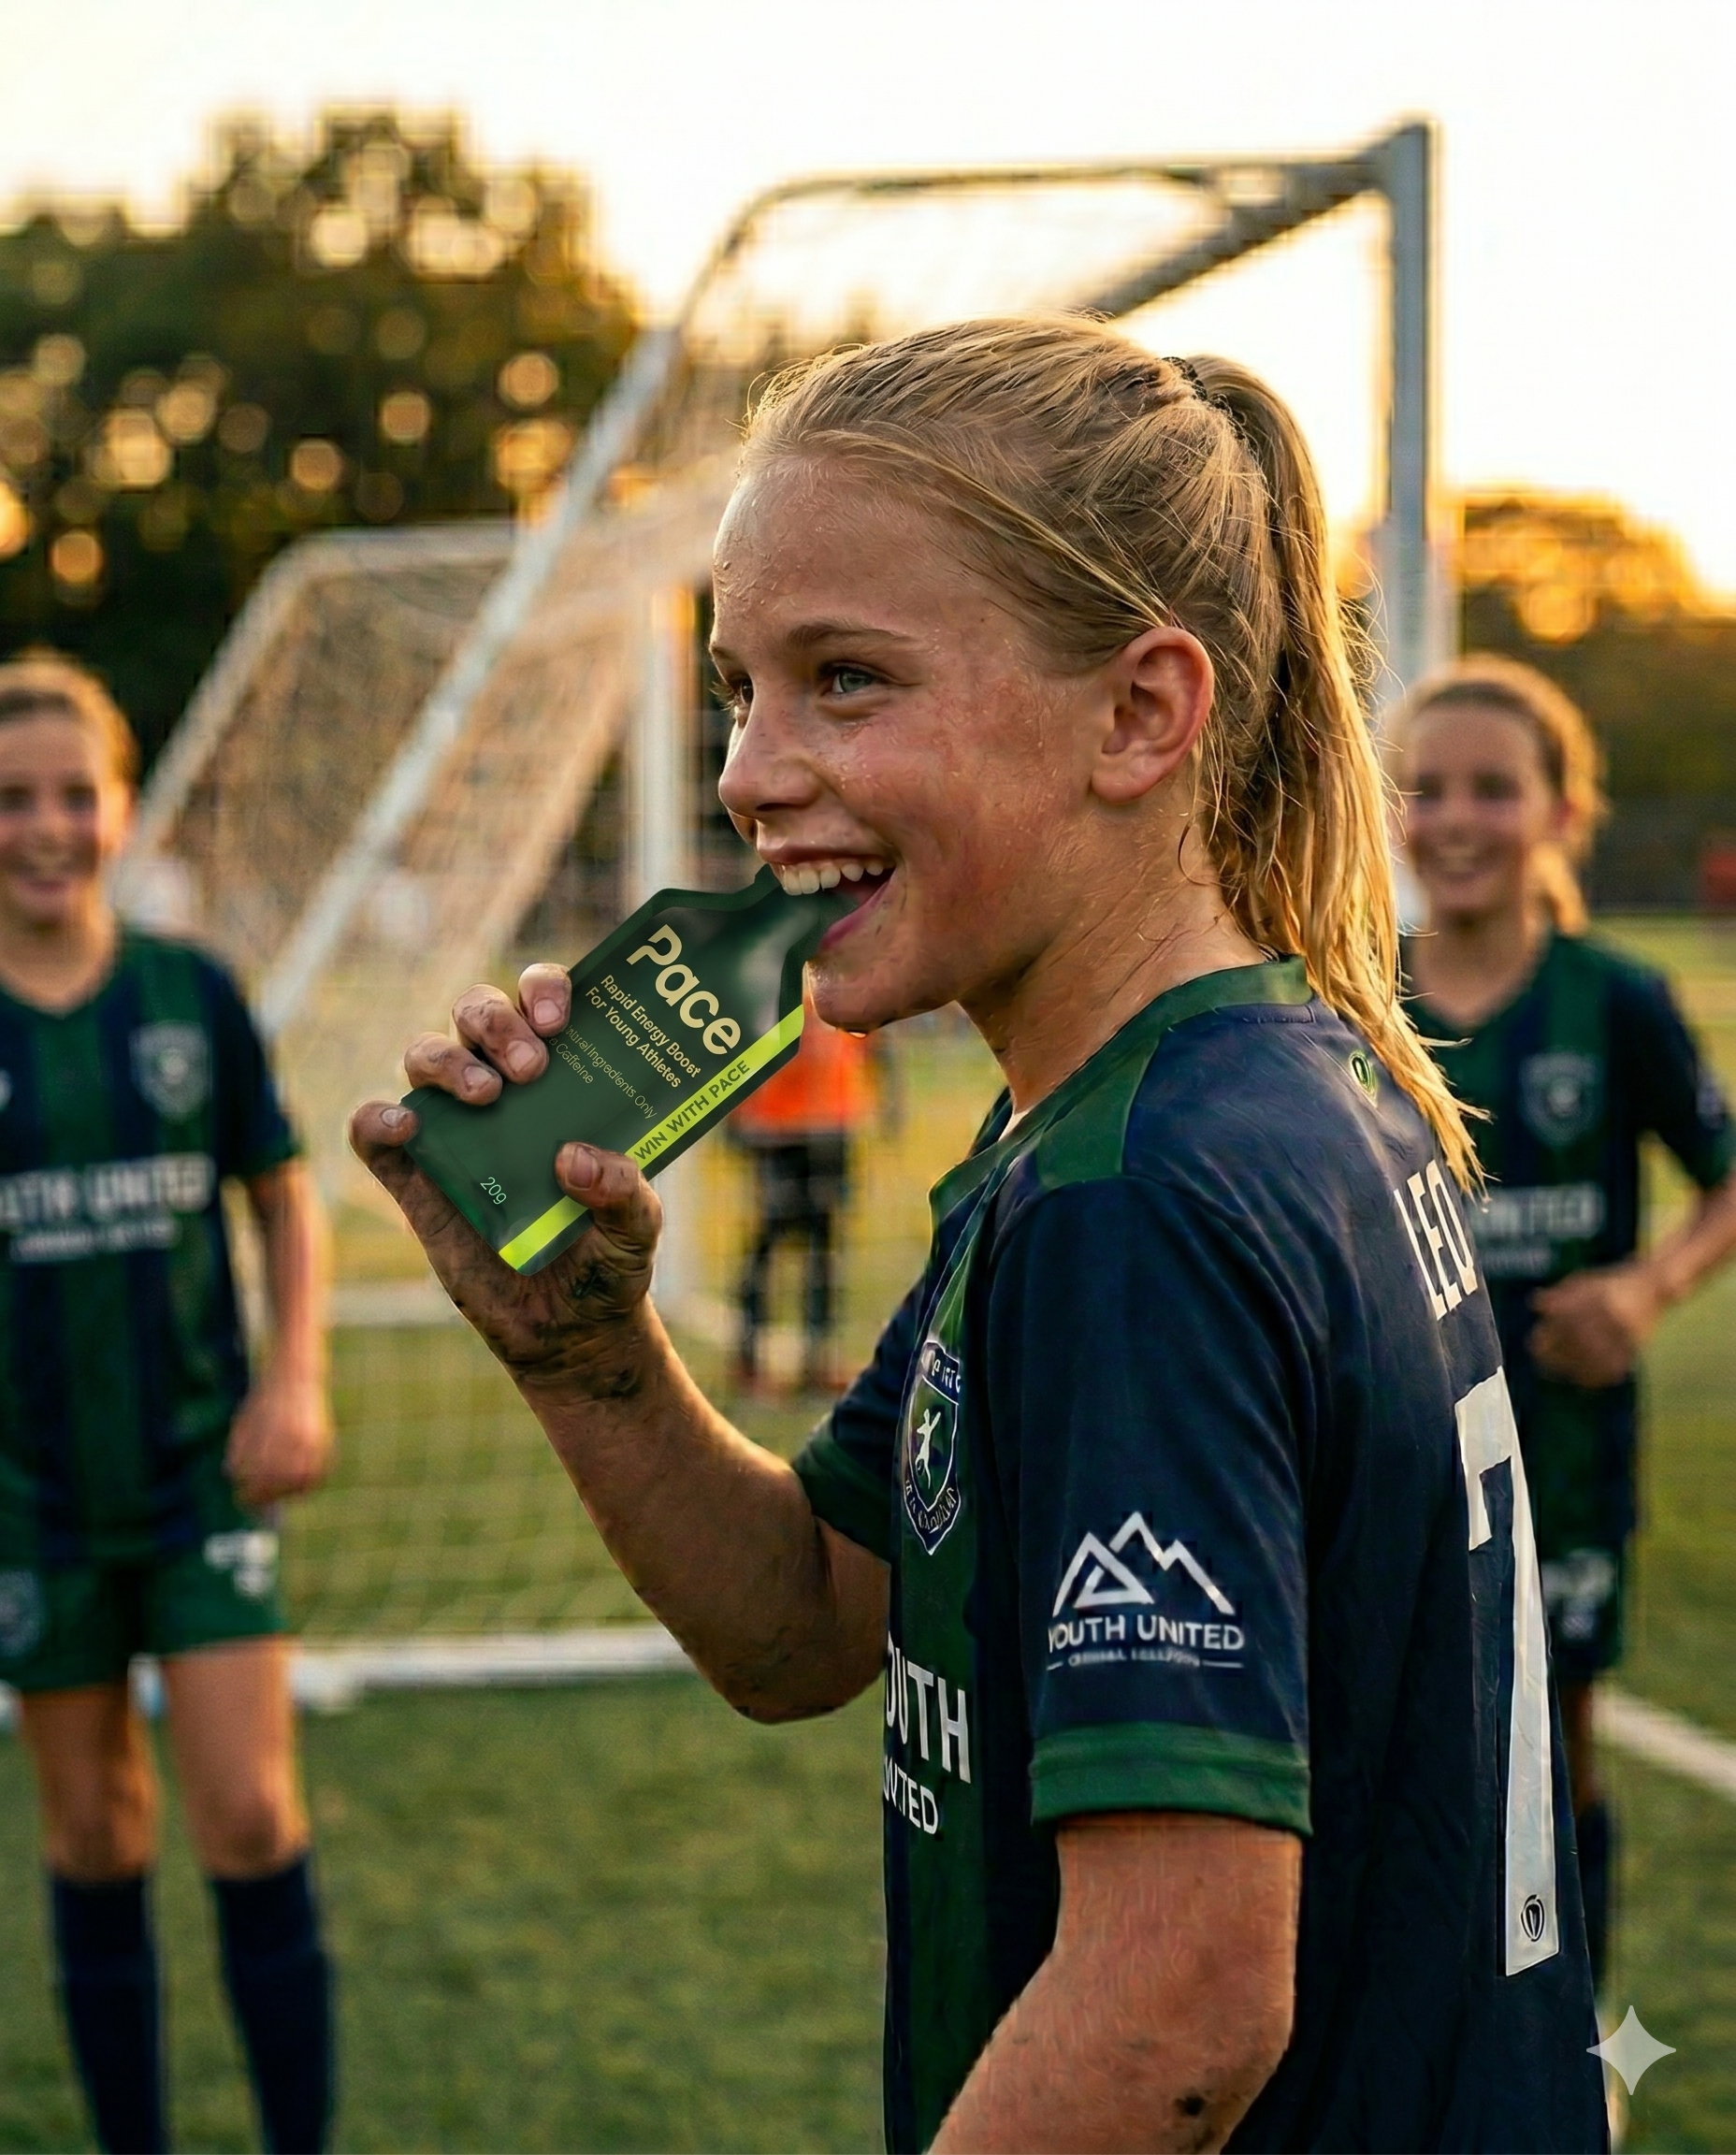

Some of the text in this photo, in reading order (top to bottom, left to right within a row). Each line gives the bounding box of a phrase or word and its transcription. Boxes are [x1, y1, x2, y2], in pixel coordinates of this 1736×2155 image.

[586, 987, 682, 1088] For Young Athletes
[600, 975, 702, 1078] Rapid Energy Boost
[626, 924, 741, 1055] Pace
[634, 1095, 658, 1119] Only
[634, 1061, 750, 1160] WIN WITH PACE
[480, 1177, 507, 1205] 20g
[1393, 1160, 1478, 1321] LEO
[1048, 1614, 1245, 1654] YOUTH UNITED
[886, 1630, 971, 1784] OUTH
